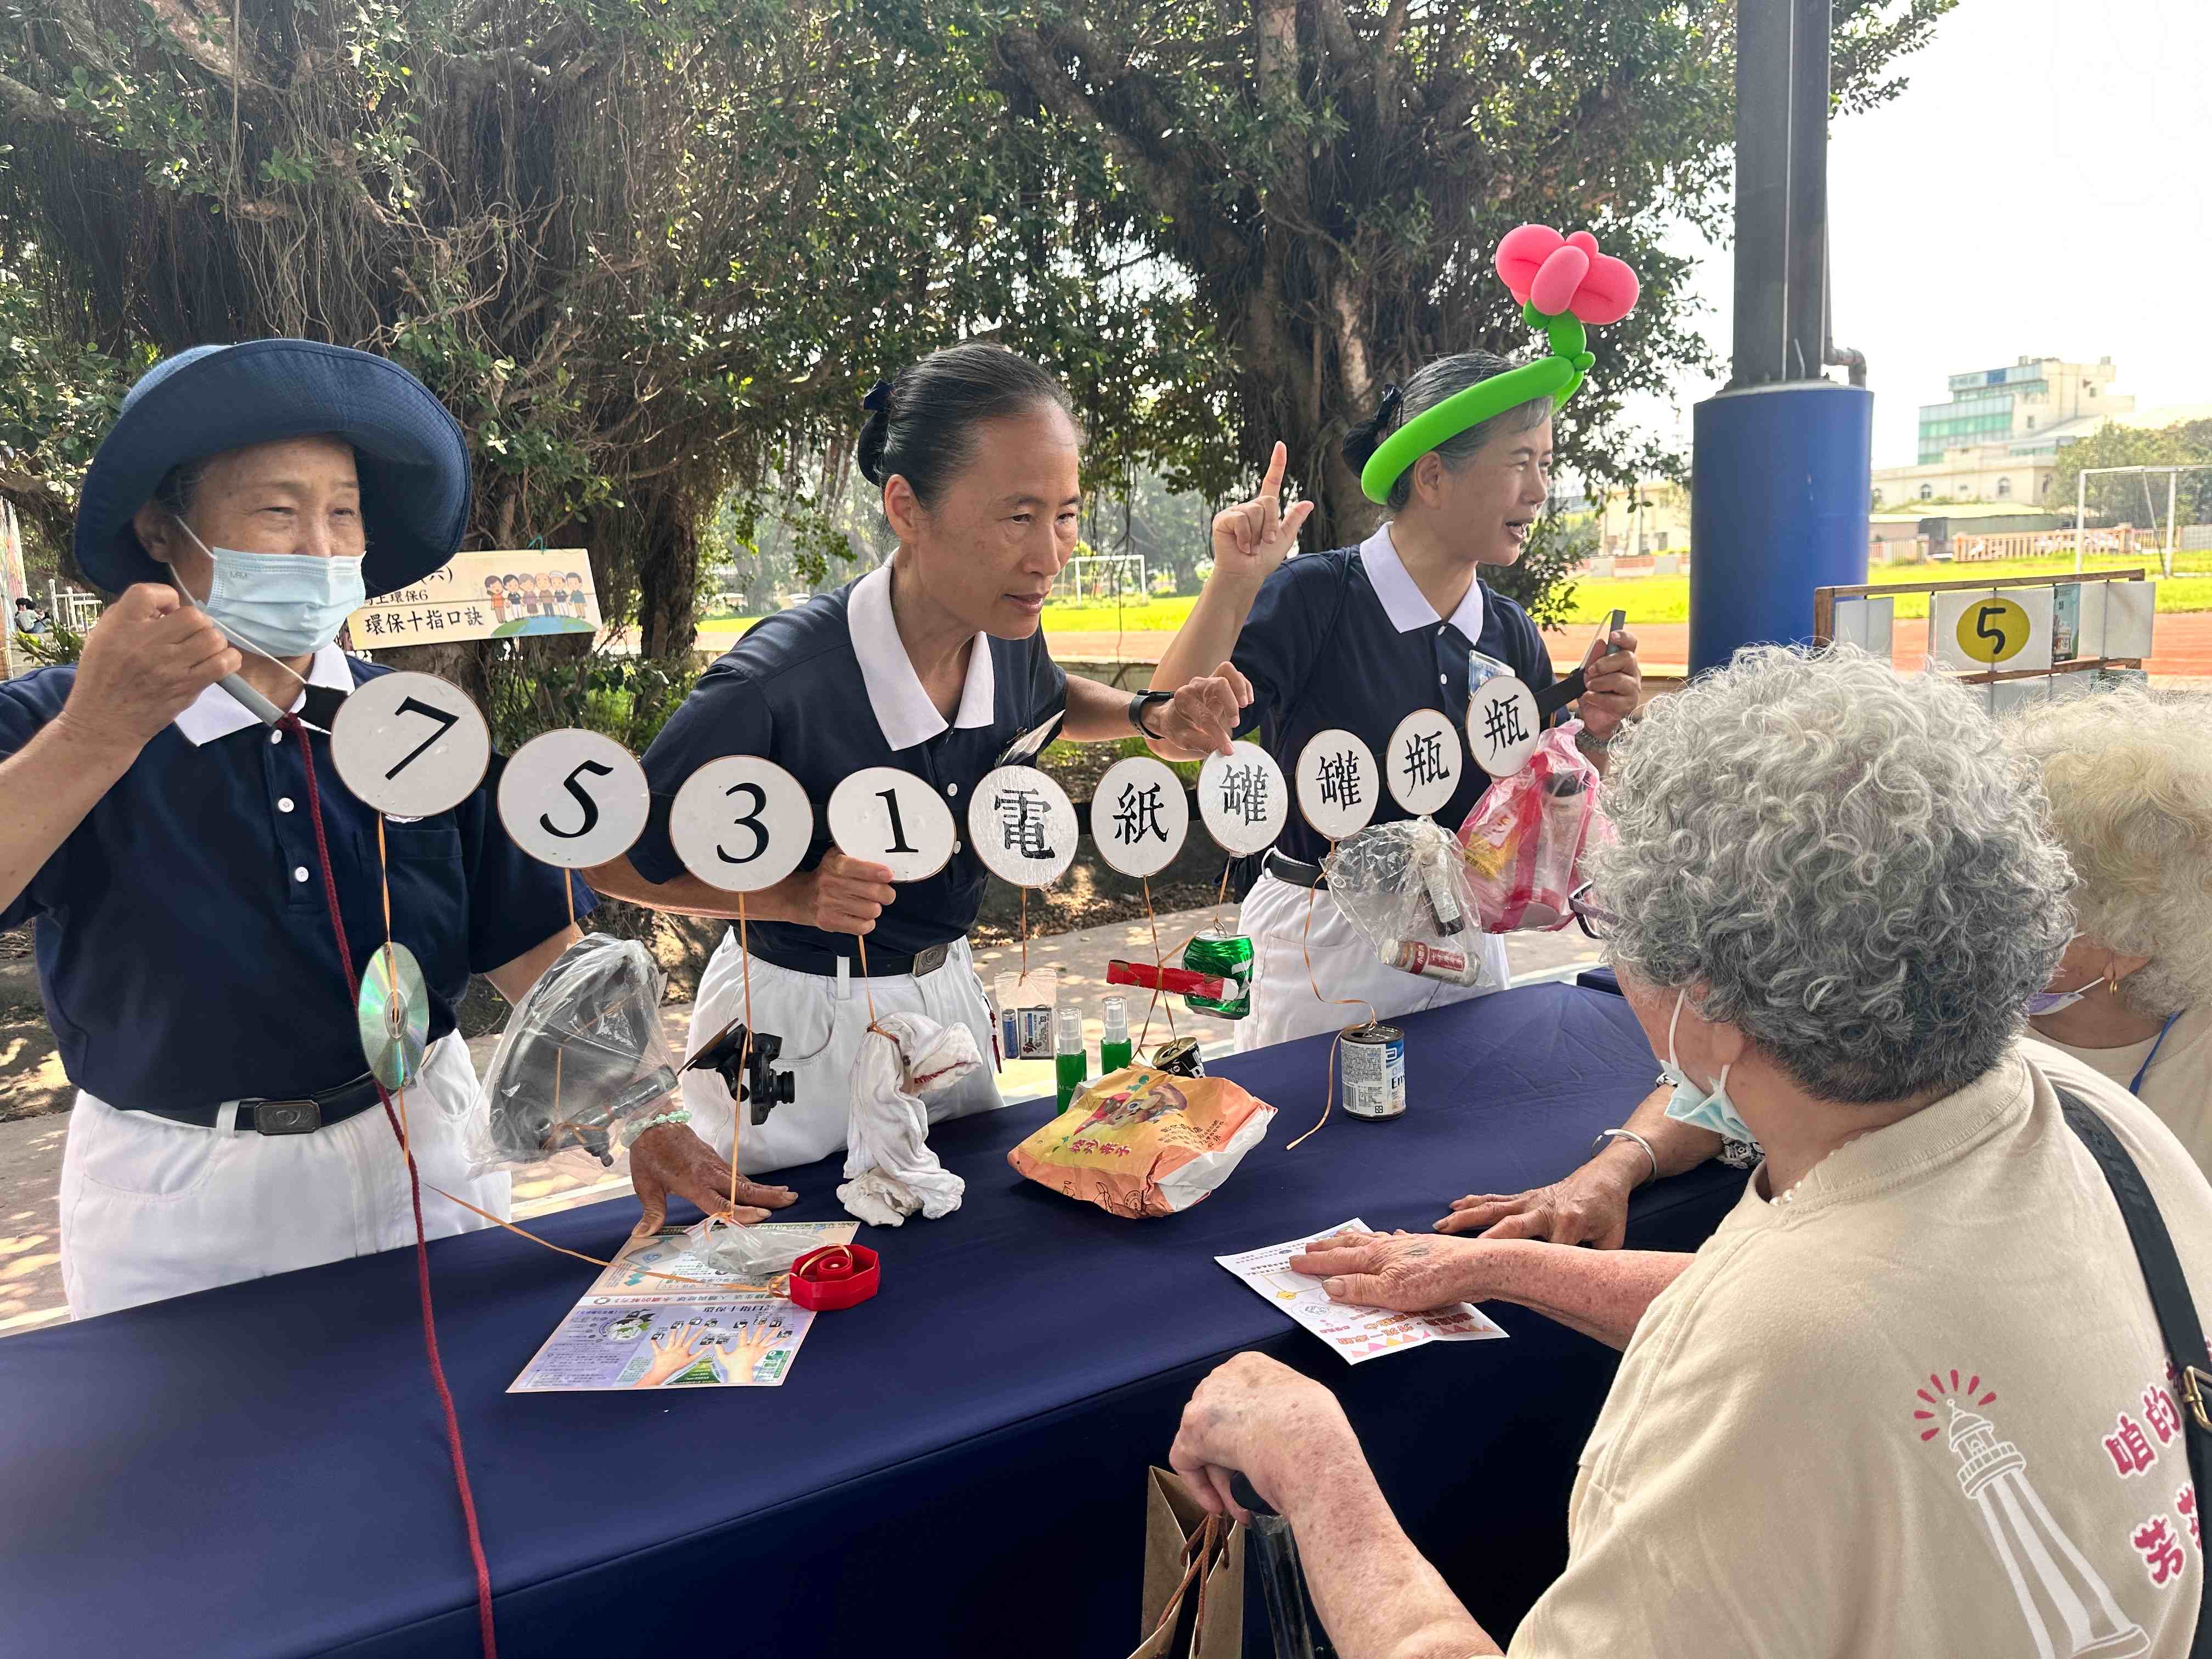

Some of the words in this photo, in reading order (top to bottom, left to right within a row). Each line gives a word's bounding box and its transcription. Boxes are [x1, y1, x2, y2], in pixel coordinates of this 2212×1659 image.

[365, 606, 485, 635] 環保十指口訣
[1976, 606, 2007, 655] 5
[385, 696, 460, 781] 7
[1483, 694, 1529, 761] 瓶
[1218, 764, 1269, 827] 罐
[1316, 749, 1362, 812] 罐
[1403, 730, 1451, 798] 瓶
[539, 760, 614, 838] 5
[716, 782, 769, 864] 3
[875, 788, 919, 854] 1
[994, 787, 1056, 860] 電
[1113, 782, 1169, 845] 紙
